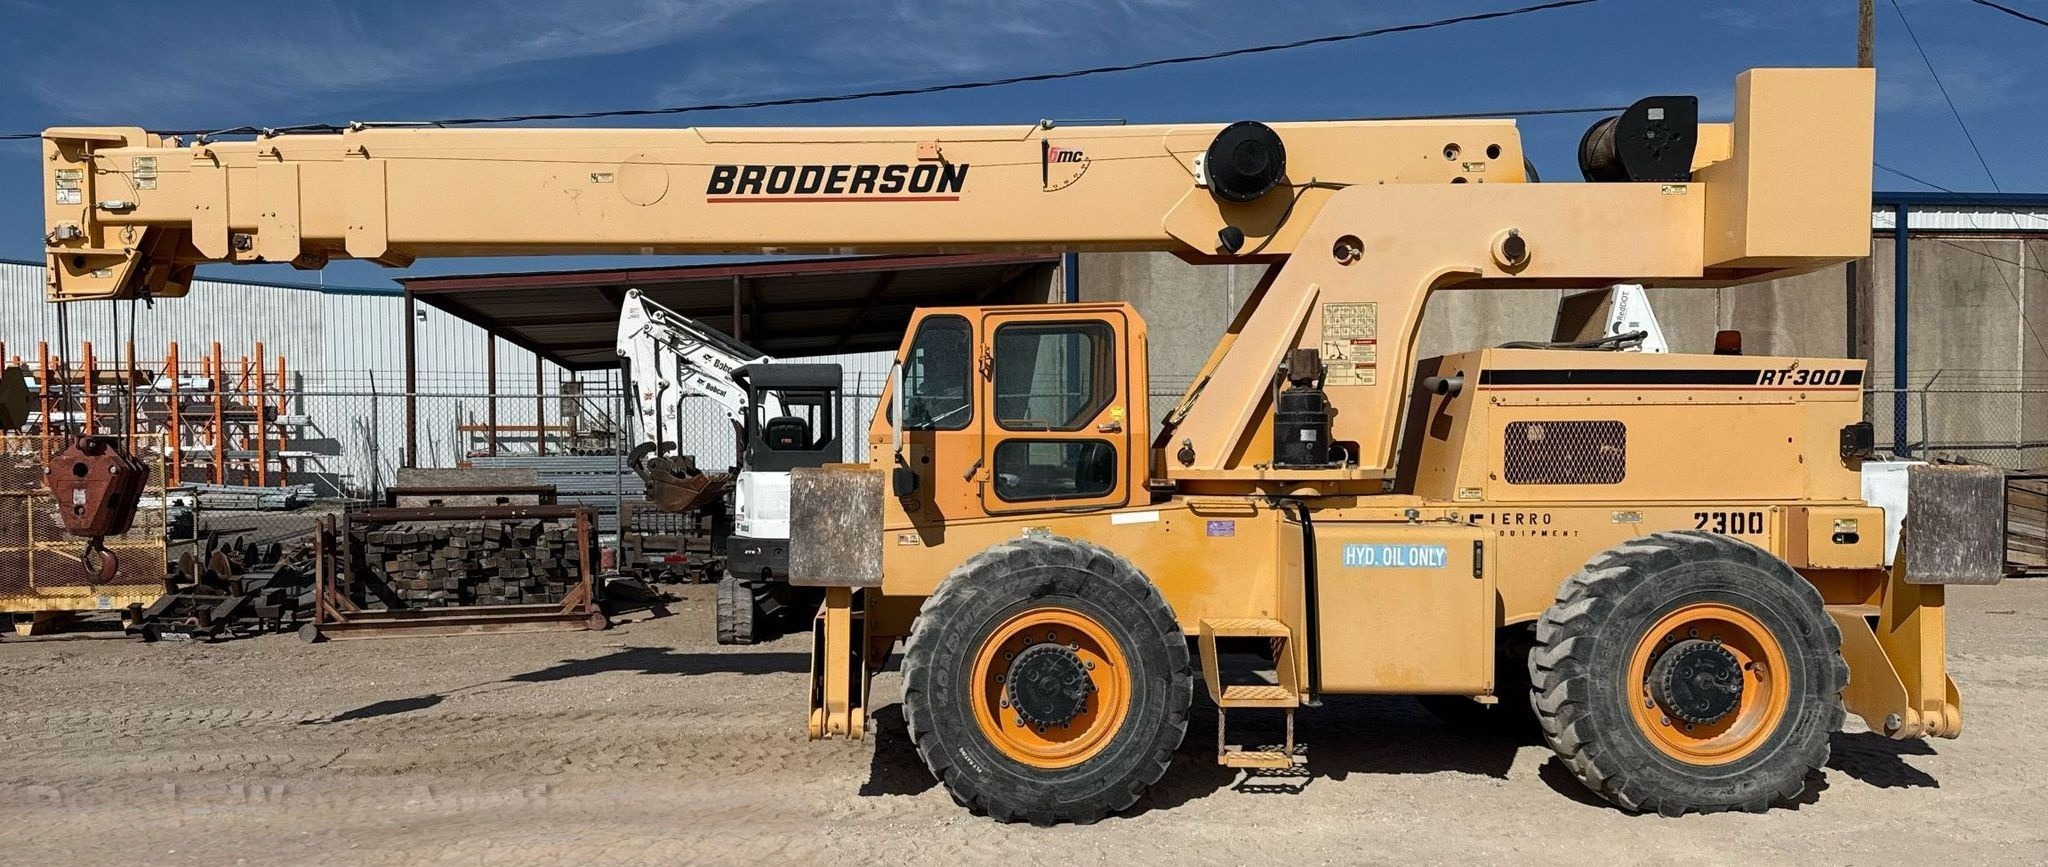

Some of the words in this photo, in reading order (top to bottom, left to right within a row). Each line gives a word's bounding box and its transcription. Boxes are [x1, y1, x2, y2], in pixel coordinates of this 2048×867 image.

[706, 163, 969, 195] BRODERSON
[713, 358, 732, 374] Bobc
[1759, 369, 1841, 386] RT-300
[705, 383, 727, 397] Bobcat
[1694, 511, 1763, 535] 2300
[1346, 547, 1379, 566] HYD.
[1383, 547, 1405, 566] OIL
[1409, 547, 1447, 566] ONLY
